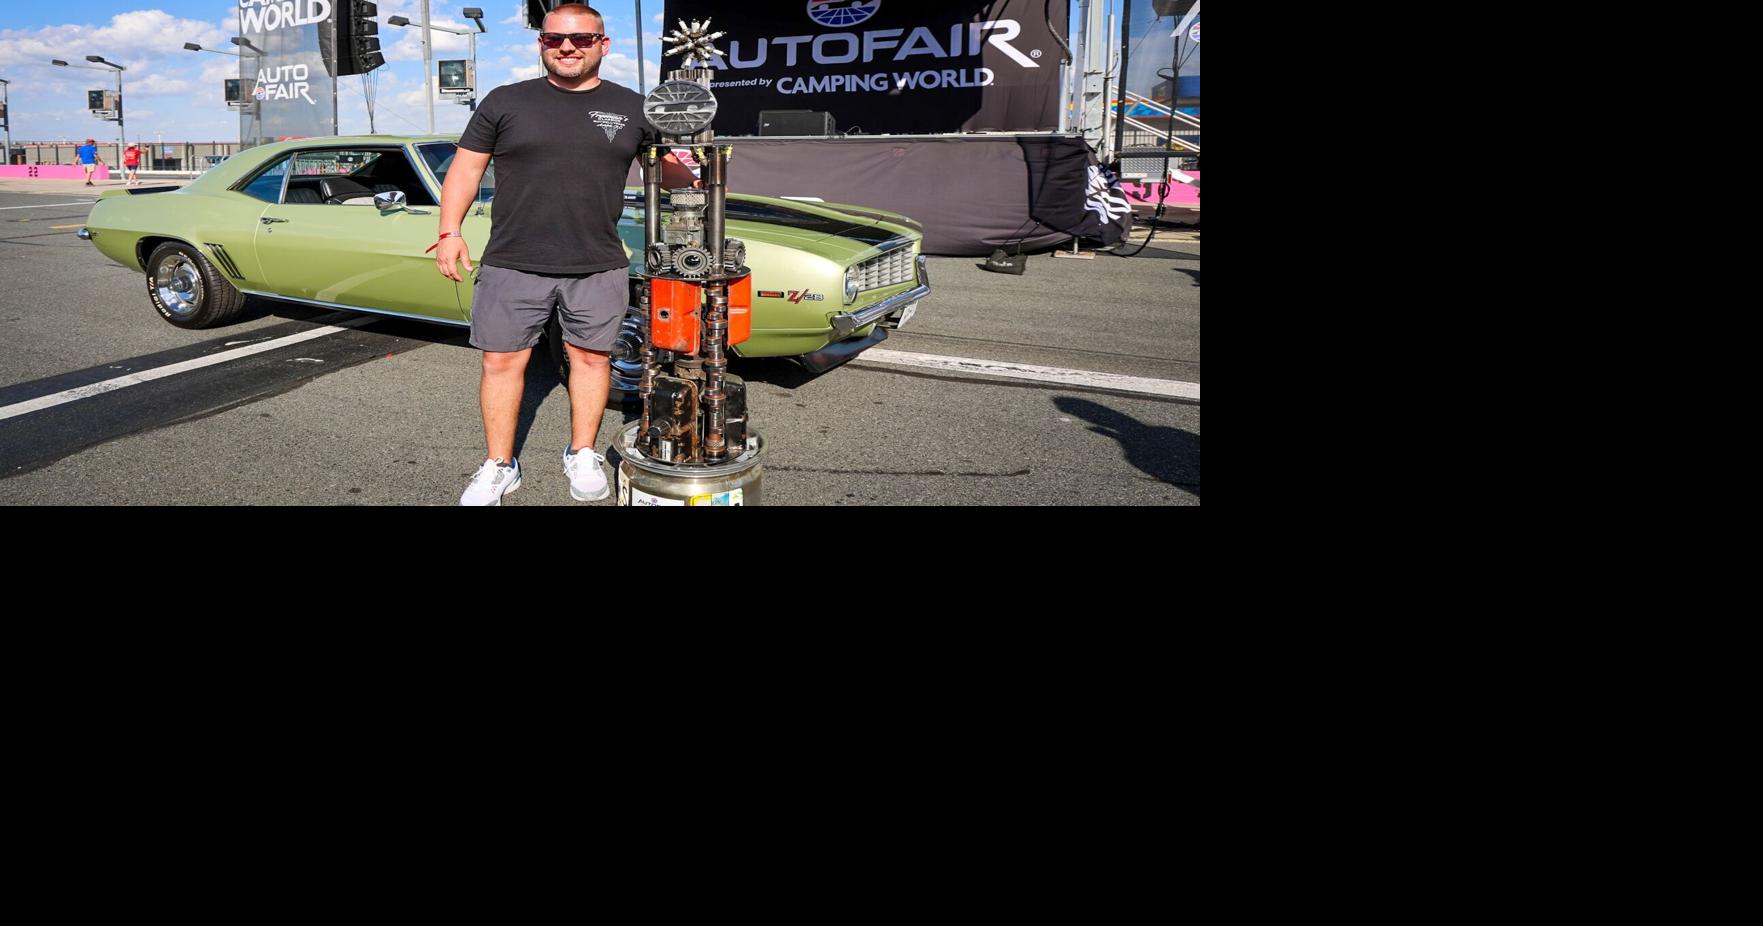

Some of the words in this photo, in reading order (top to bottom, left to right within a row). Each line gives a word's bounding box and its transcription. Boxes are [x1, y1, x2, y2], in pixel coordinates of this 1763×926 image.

[252, 64, 308, 96] AUTO
[759, 78, 773, 87] by
[776, 73, 889, 95] CAMPING
[265, 81, 317, 105] FAIR
[28, 166, 38, 177] 22
[787, 289, 824, 304] Z/28
